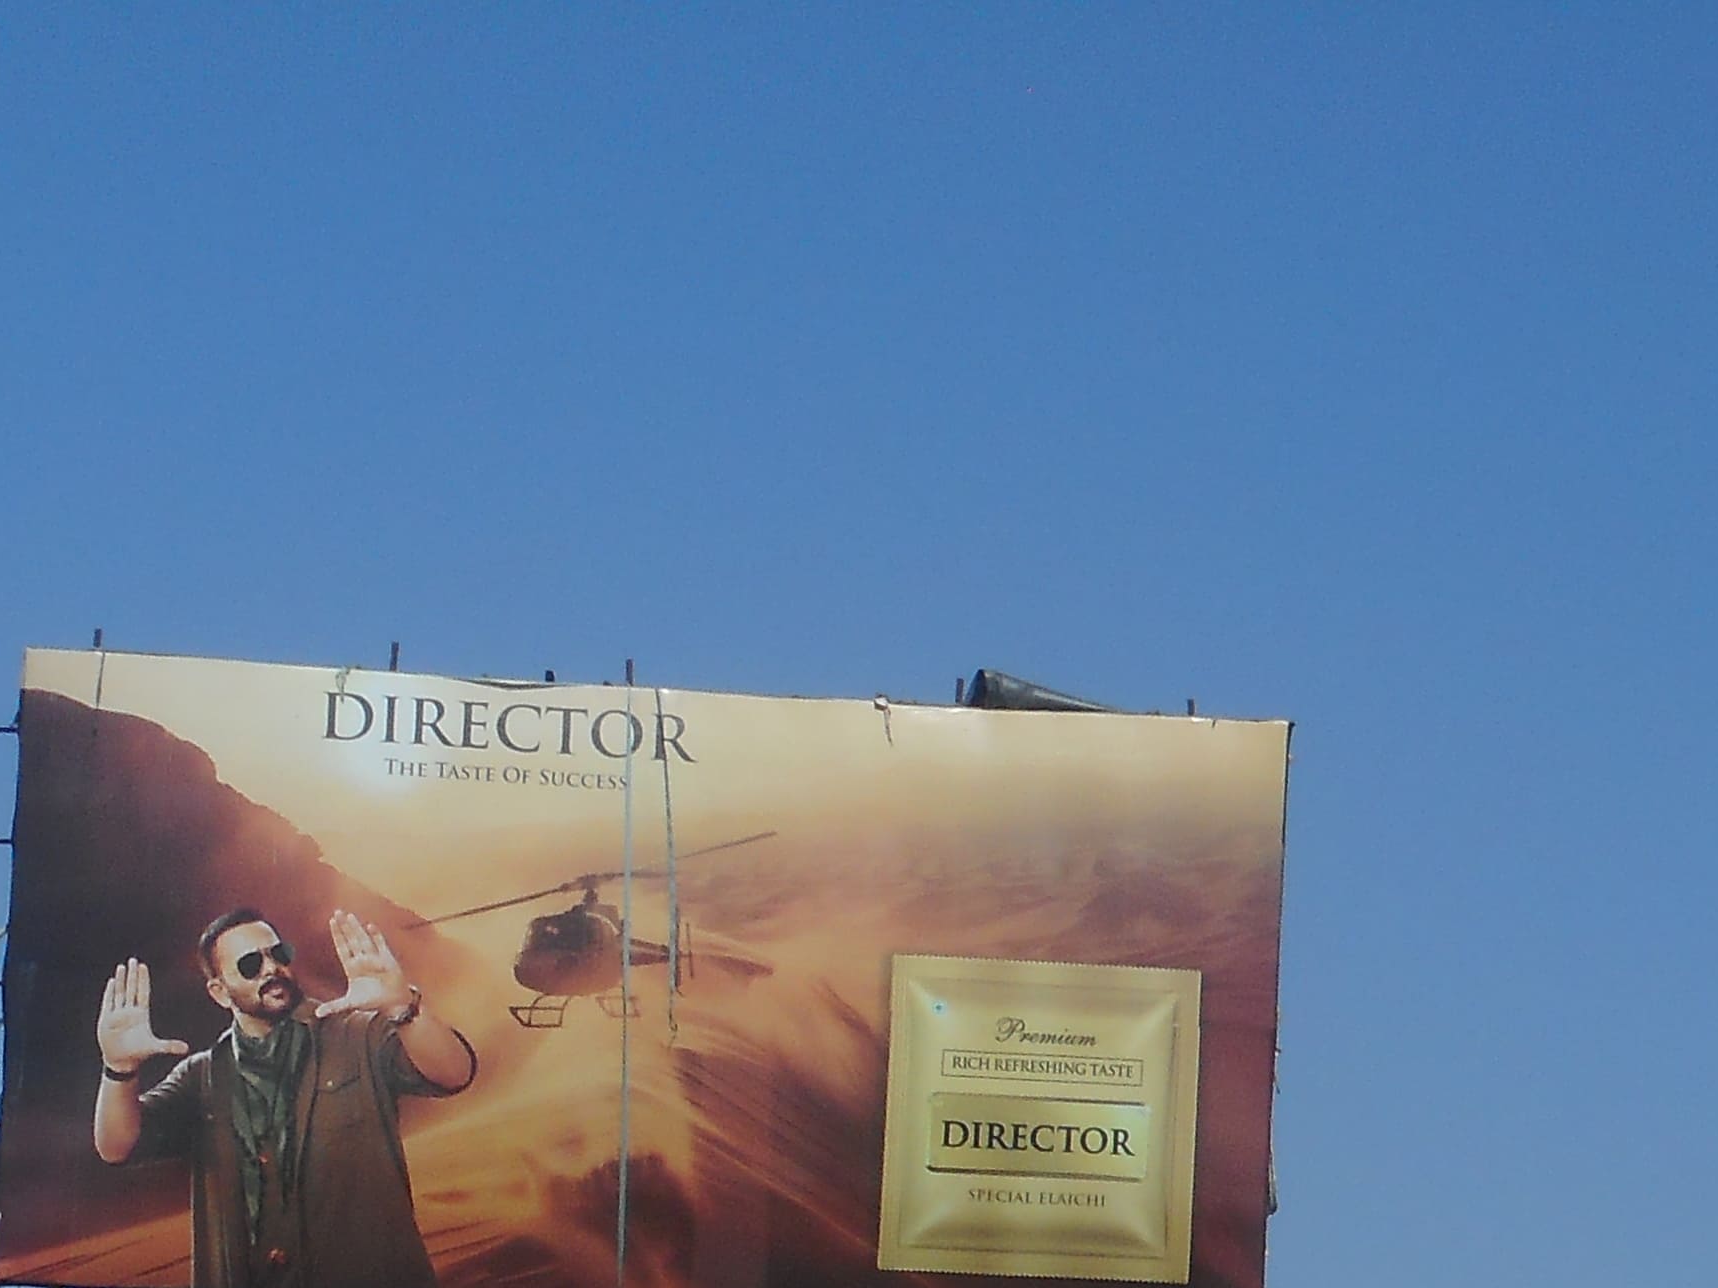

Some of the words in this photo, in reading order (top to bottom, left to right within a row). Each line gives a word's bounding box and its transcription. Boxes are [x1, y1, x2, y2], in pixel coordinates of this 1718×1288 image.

[324, 691, 698, 764] DIRECTOR
[995, 1016, 1098, 1047] Premium
[951, 1055, 990, 1072] RICH
[994, 1057, 1086, 1077] REFRESHING
[1088, 1062, 1134, 1079] TASTE
[941, 1119, 1136, 1157] DIRECTOR
[968, 1188, 1033, 1205] SPECIAL
[1039, 1192, 1106, 1208] ELAICHI
